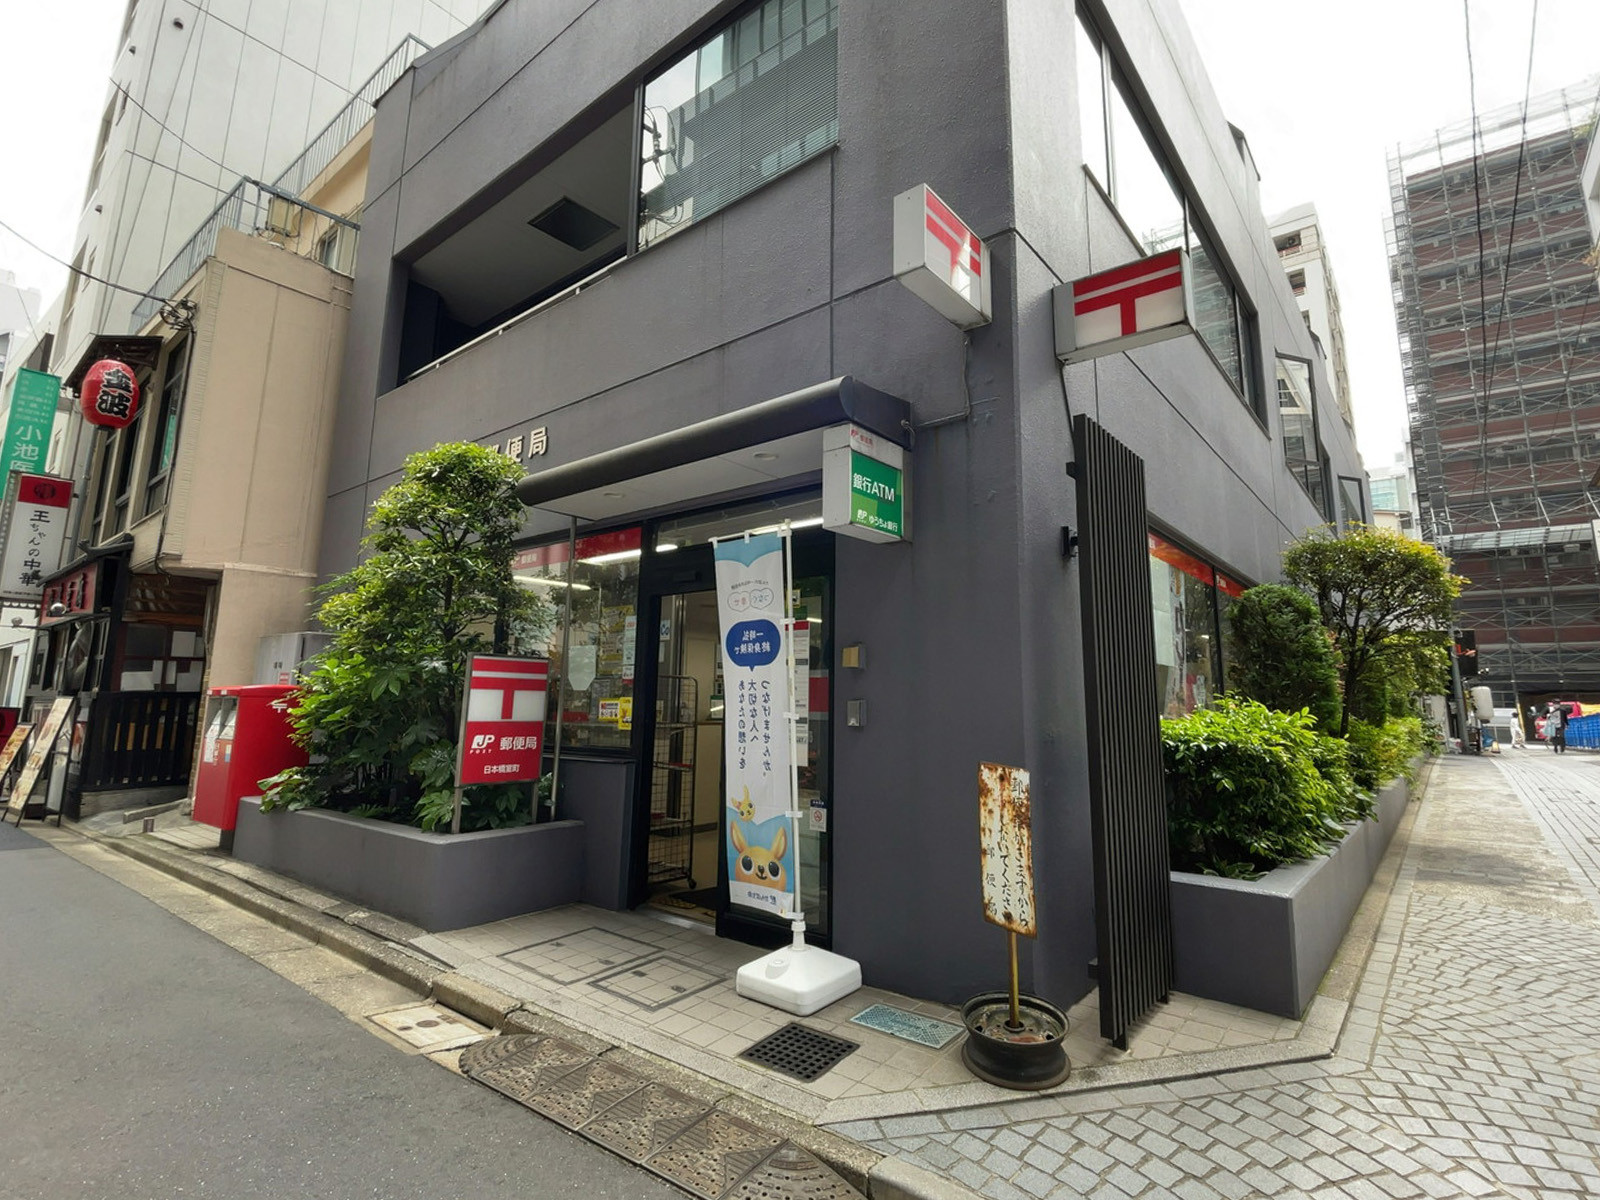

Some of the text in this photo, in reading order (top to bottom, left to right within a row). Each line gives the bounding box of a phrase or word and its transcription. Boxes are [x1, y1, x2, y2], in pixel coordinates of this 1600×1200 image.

[853, 473, 895, 502] 銀行ATM
[19, 510, 50, 586] 王ちゃんの中華
[500, 736, 537, 751] 郵便局
